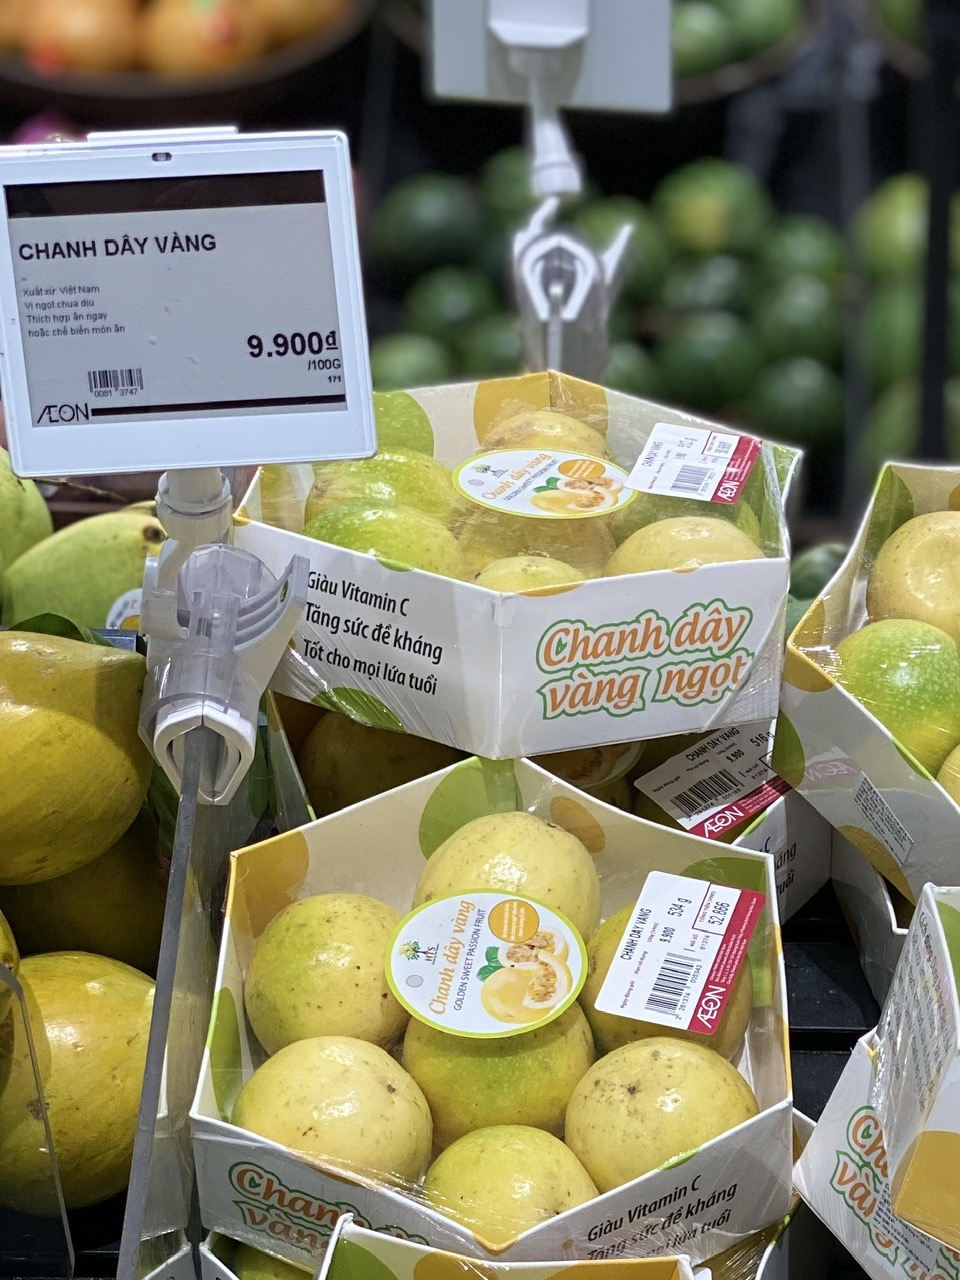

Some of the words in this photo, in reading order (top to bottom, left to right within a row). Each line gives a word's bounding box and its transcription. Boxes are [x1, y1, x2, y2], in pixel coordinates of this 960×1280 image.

[19, 241, 96, 260] CHANH
[104, 235, 148, 256] DÂY
[155, 232, 216, 254] VÀNG
[60, 285, 76, 295] Việt
[78, 286, 100, 294] Nam
[26, 315, 50, 324] Thích
[87, 313, 107, 321] ngay
[92, 325, 112, 334] món
[307, 359, 341, 371] /100G
[308, 571, 337, 596] Giàu
[342, 580, 396, 613] Vitamin
[400, 598, 410, 616] C
[306, 602, 340, 634] Tăng
[343, 617, 369, 638] sức
[372, 623, 392, 645] đề
[393, 628, 442, 664] kháng
[544, 617, 665, 666] Chanh
[675, 607, 745, 651] dây
[304, 639, 323, 661] Tốt
[327, 648, 350, 669] cho
[353, 659, 381, 680] mọi
[383, 663, 405, 685] lứa
[409, 673, 437, 695] tuổi
[549, 672, 641, 712] vàng
[662, 655, 747, 700] ngọt
[667, 904, 682, 917] 534
[678, 897, 692, 905] g
[708, 901, 730, 926] 52.866
[451, 900, 475, 932] vàng
[620, 938, 635, 961] CHANH
[634, 924, 644, 939] DAY
[640, 907, 651, 925] VANG
[659, 927, 676, 943] 9.900
[444, 936, 465, 964] dây
[429, 967, 455, 1015] Chanh
[588, 1217, 623, 1242] Giàu
[628, 1185, 687, 1223] Vitamin
[692, 1175, 701, 1191] C
